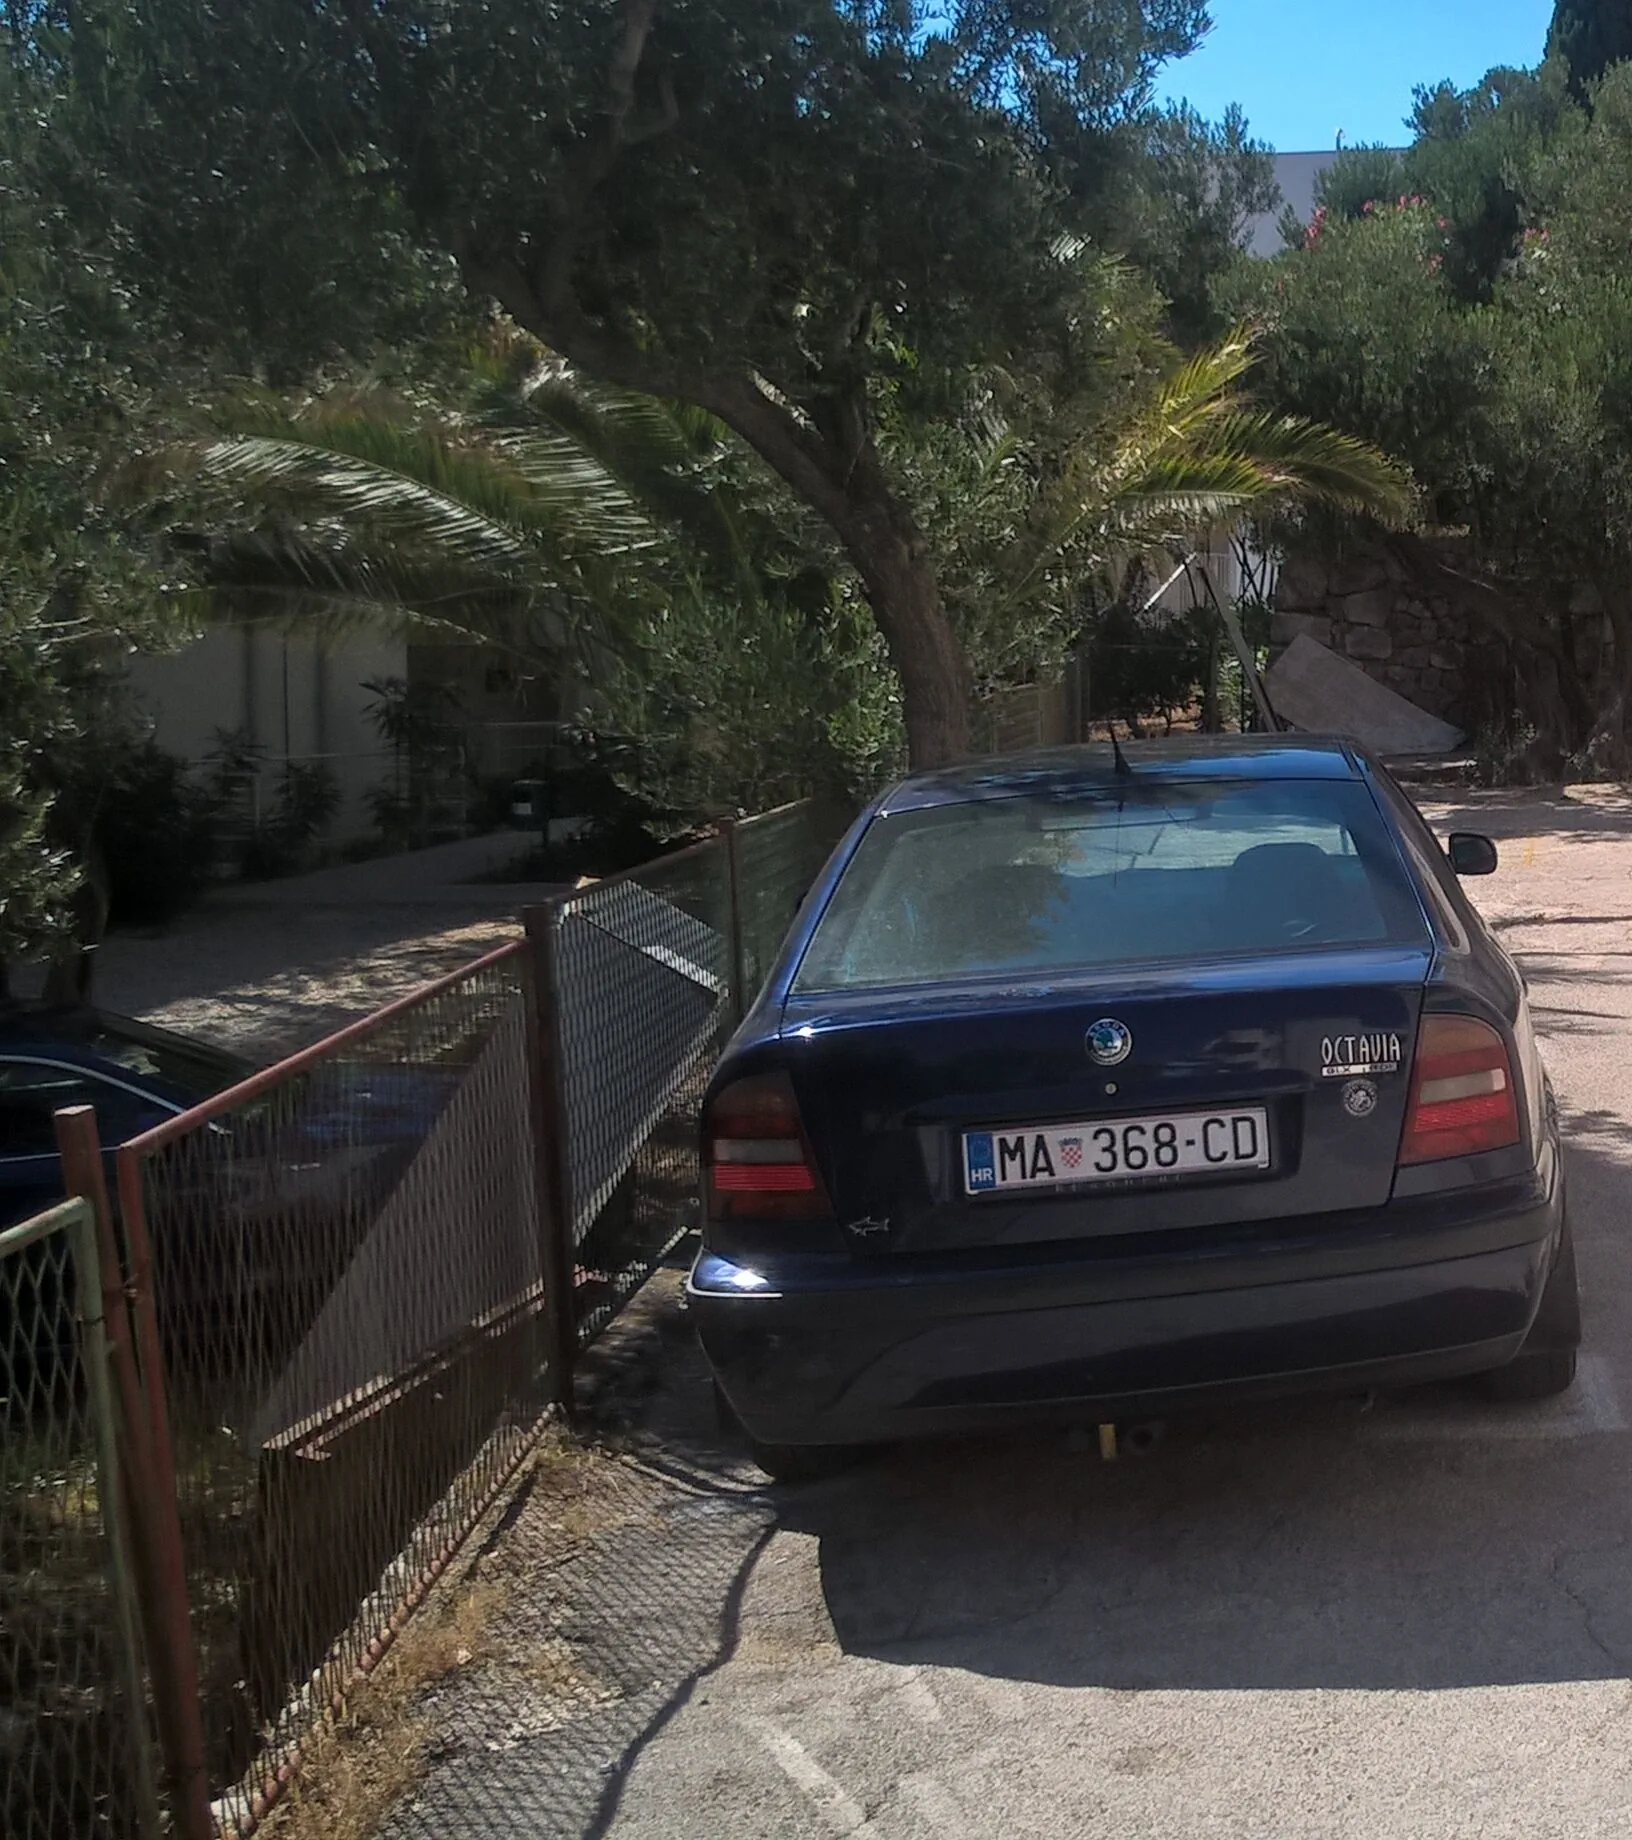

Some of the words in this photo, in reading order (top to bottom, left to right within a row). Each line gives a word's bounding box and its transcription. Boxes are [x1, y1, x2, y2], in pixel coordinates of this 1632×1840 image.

[1321, 1033, 1400, 1065] OCTAVIA
[998, 1134, 1056, 1181] MA
[1093, 1115, 1258, 1173] 368-CD
[971, 1168, 993, 1183] HR
